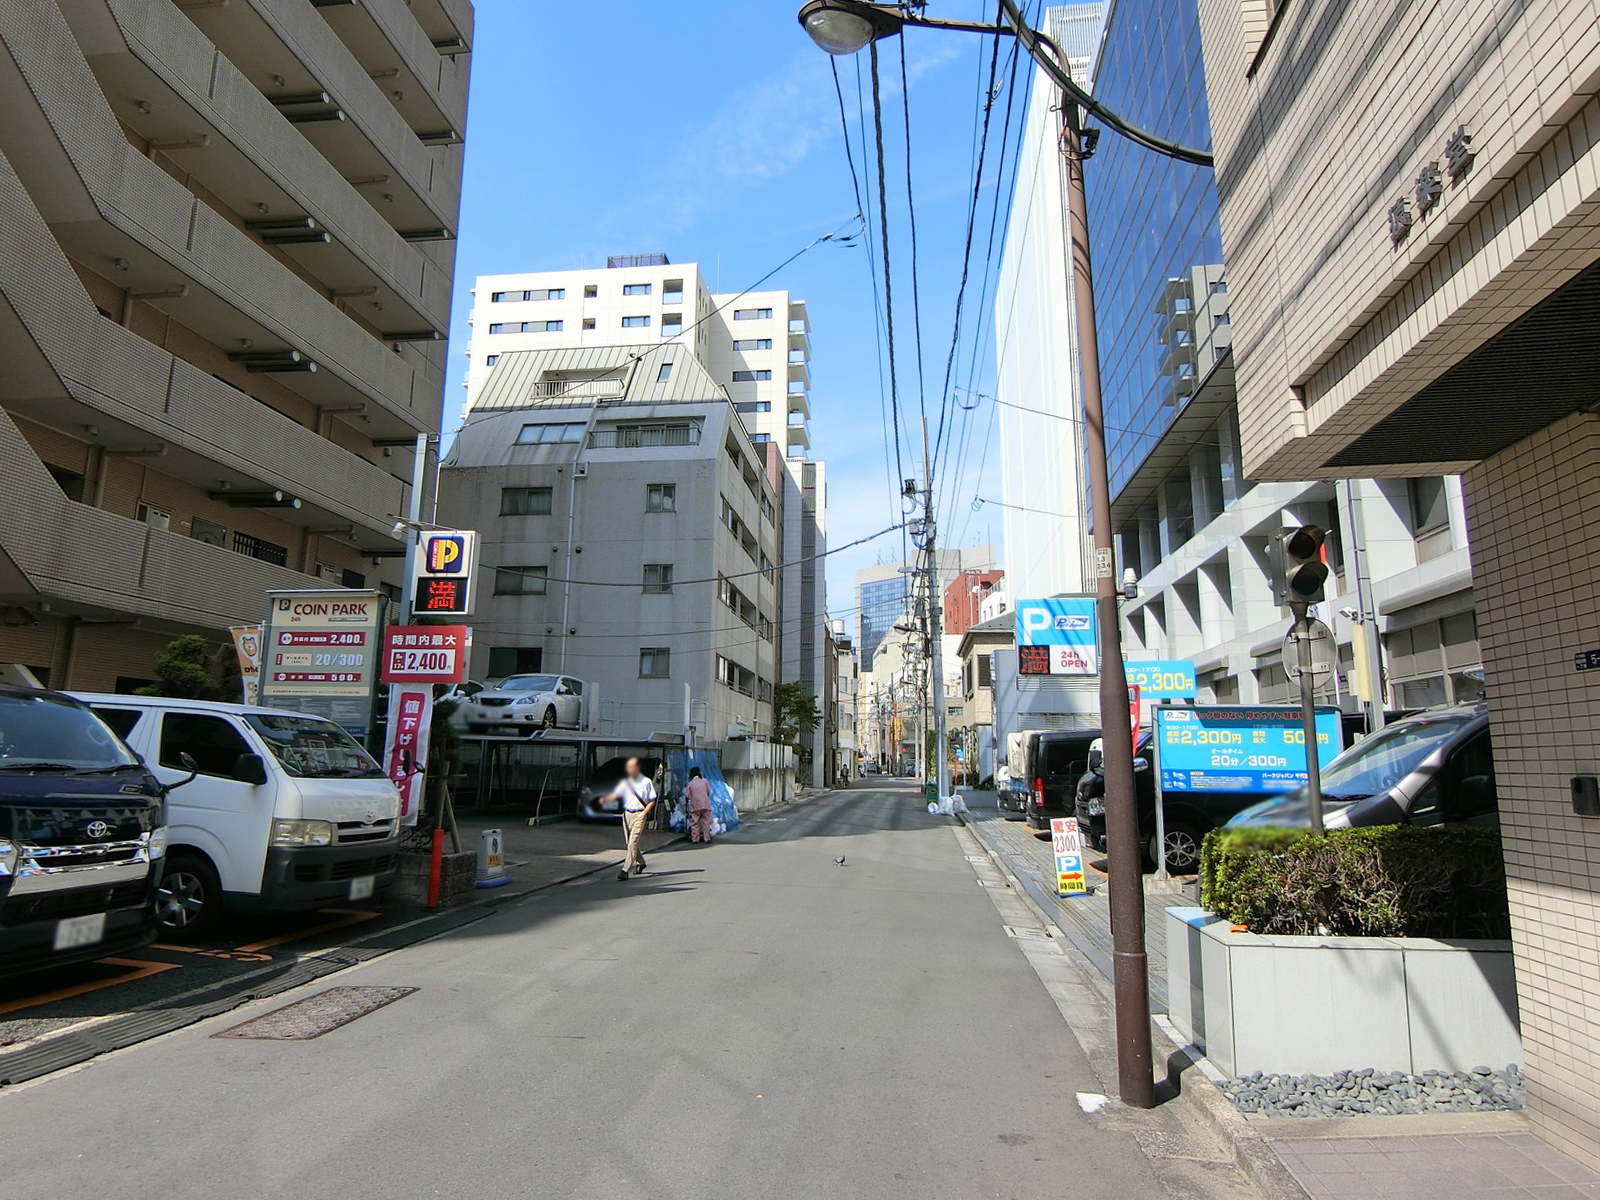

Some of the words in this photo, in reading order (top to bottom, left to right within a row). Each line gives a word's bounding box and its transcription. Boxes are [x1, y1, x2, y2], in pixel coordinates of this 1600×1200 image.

[428, 581, 456, 609] 満
[293, 604, 328, 615] COIN
[331, 604, 367, 614] PARK
[1023, 608, 1052, 645] P
[392, 635, 457, 646] 時間内最大
[315, 653, 364, 666] 20/300
[1061, 651, 1079, 659] 24h
[1181, 731, 1242, 745] 2,300円
[1283, 730, 1329, 744] 50円
[396, 700, 420, 809] 値下げしまし
[1060, 856, 1077, 871] P
